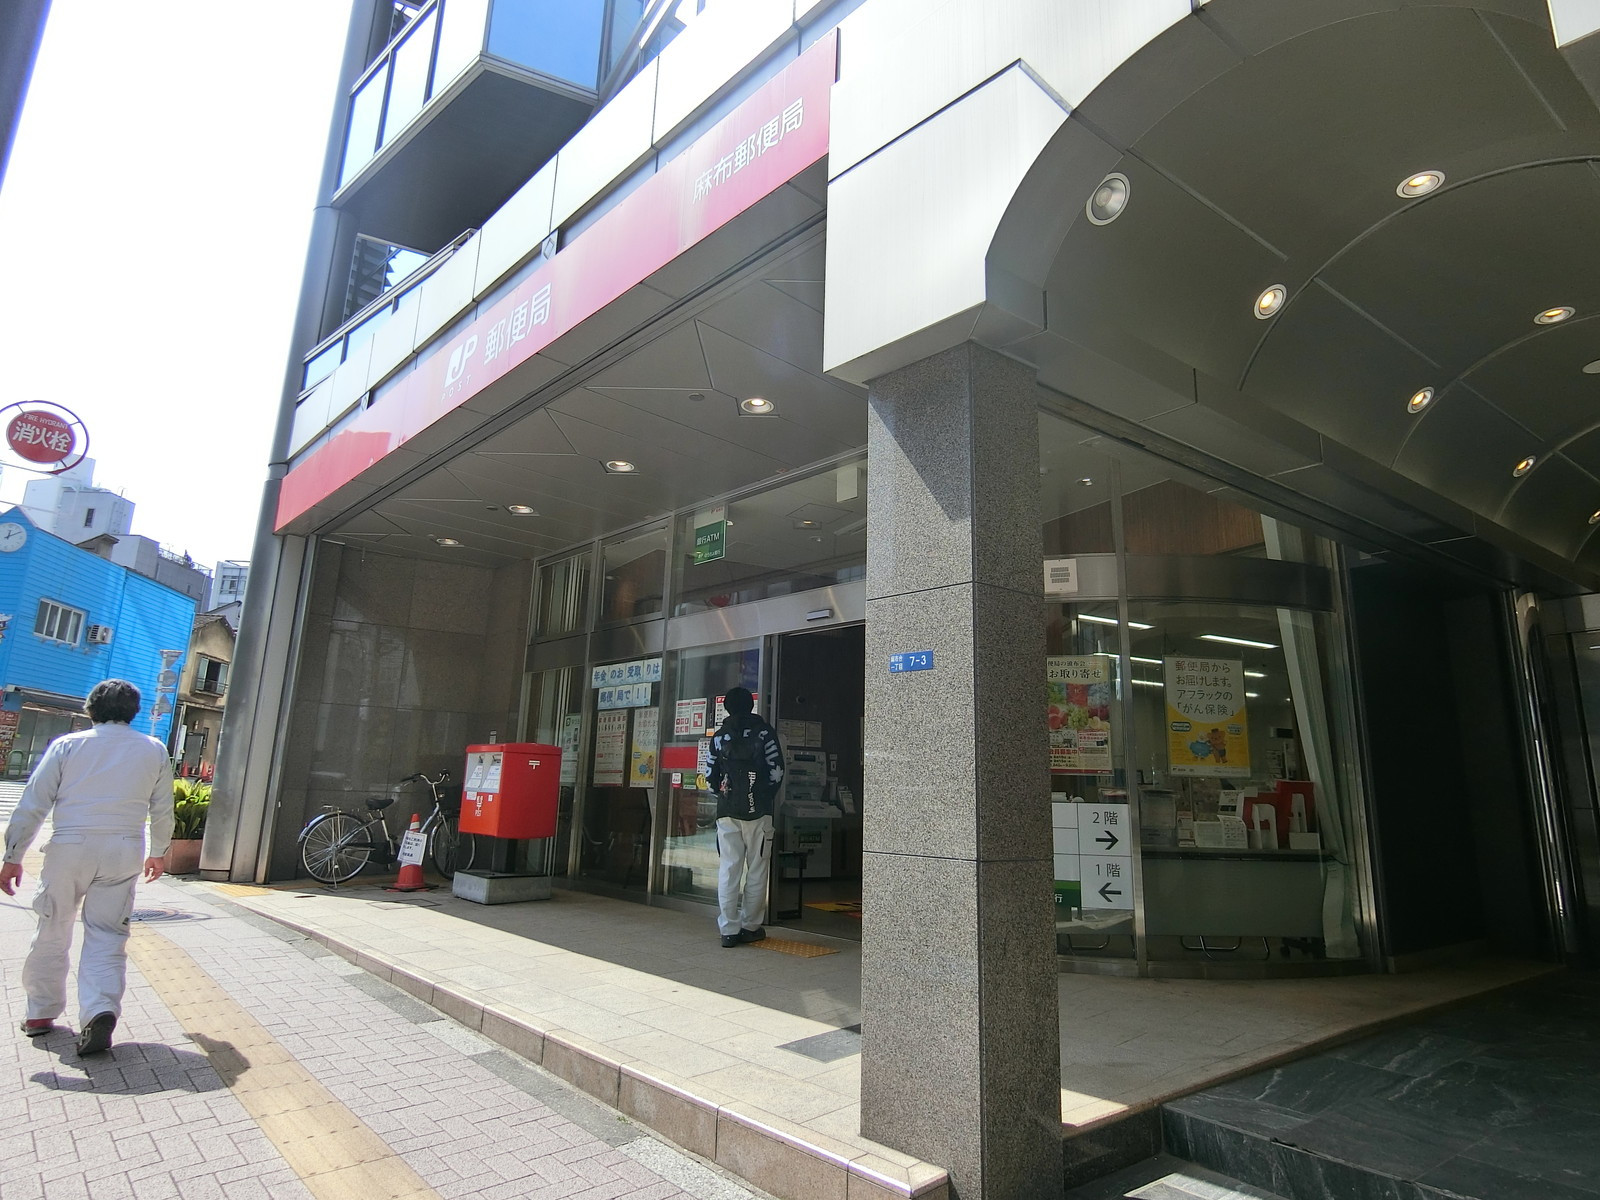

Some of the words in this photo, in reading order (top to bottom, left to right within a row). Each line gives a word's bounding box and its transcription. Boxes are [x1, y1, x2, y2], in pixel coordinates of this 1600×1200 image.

[692, 96, 804, 205] 麻布郵便局
[483, 282, 552, 365] 郵便局
[23, 413, 39, 422] FIRE
[39, 418, 68, 430] HYDRANT
[12, 420, 72, 453] 消火栓
[909, 655, 927, 667] 7-3
[1175, 660, 1231, 673] 郵便局から
[1049, 668, 1102, 679] お取り寄せ
[1175, 675, 1232, 687] お届けします。
[1176, 689, 1233, 701] アフラックの
[1177, 702, 1234, 717] 「がん保険」
[1092, 811, 1119, 825] 2階
[1095, 863, 1121, 878] 1階
